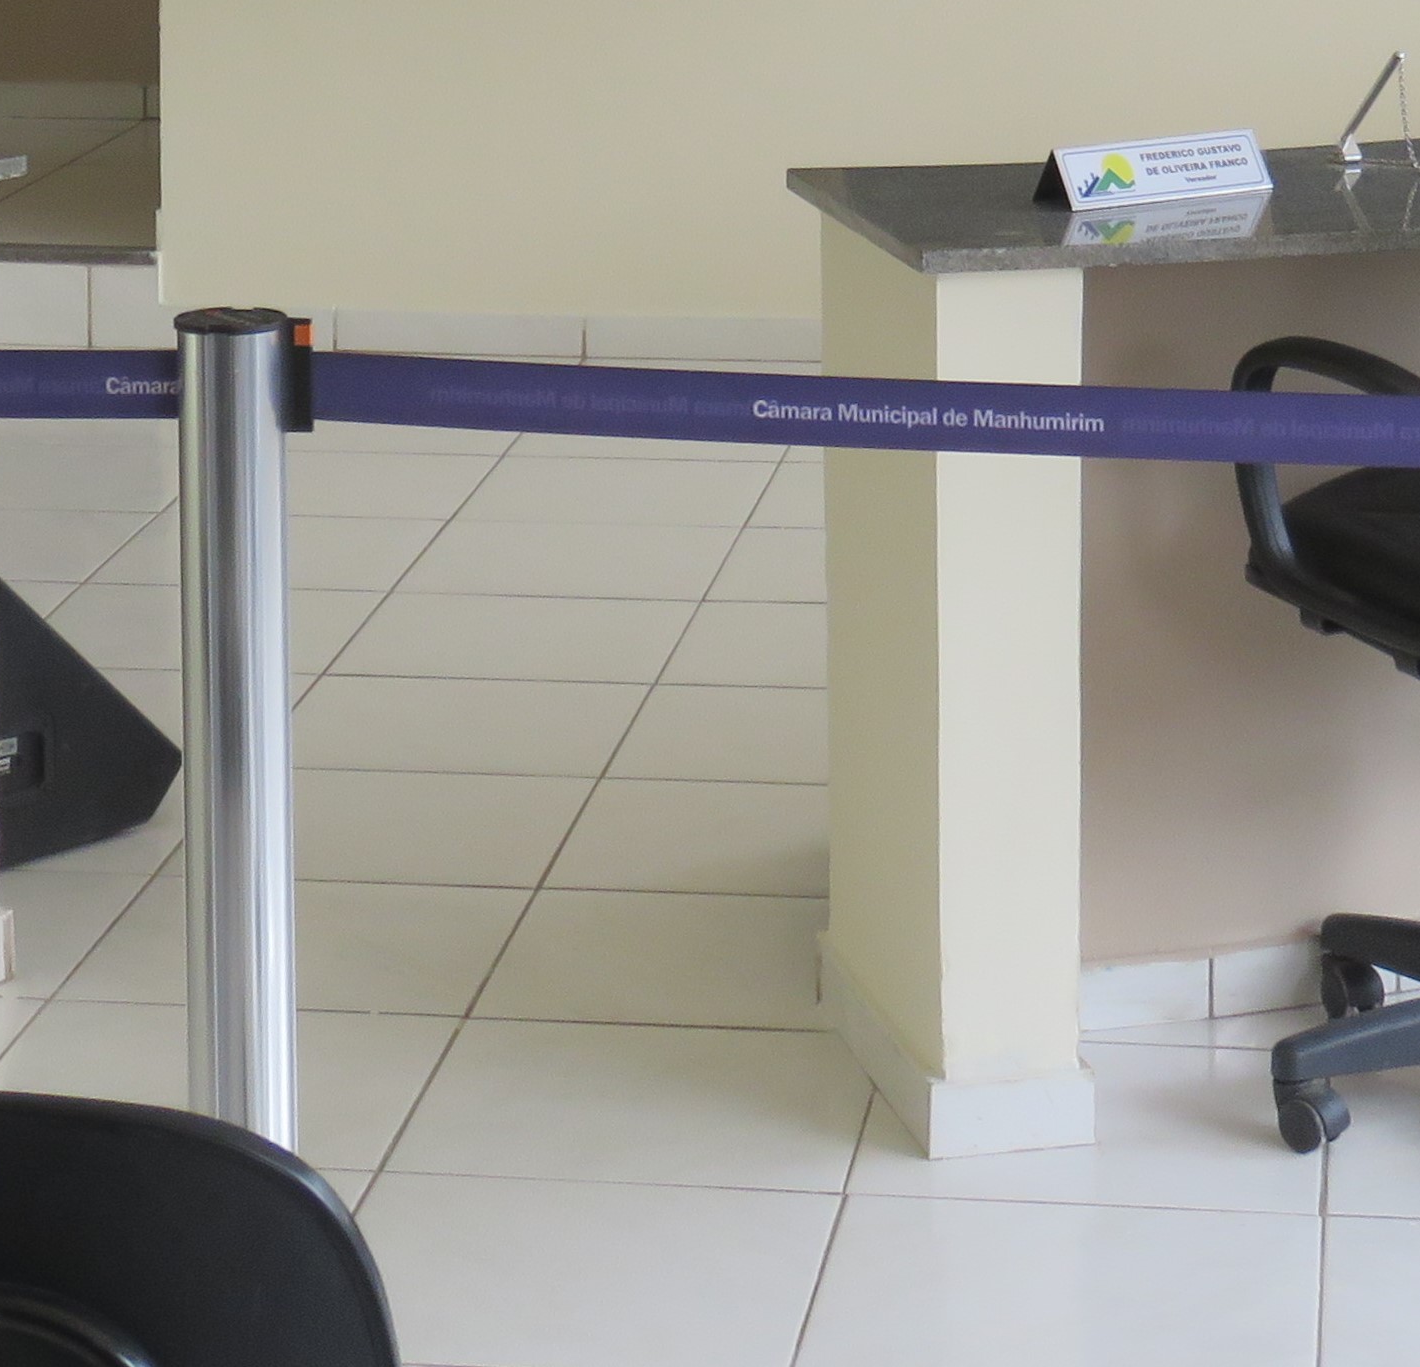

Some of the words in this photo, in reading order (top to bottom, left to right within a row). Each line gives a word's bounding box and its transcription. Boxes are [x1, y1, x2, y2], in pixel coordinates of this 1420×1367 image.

[1139, 149, 1194, 162] FREDERICO
[1197, 143, 1242, 156] GUSTAVO
[1146, 165, 1161, 176] DE
[1163, 160, 1208, 173] OLIVEIRA
[1209, 156, 1248, 169] FRANCO
[752, 399, 833, 422] Câmara
[837, 402, 938, 429] Municipal
[942, 408, 969, 428] de
[973, 408, 1105, 433] Manhumirim
